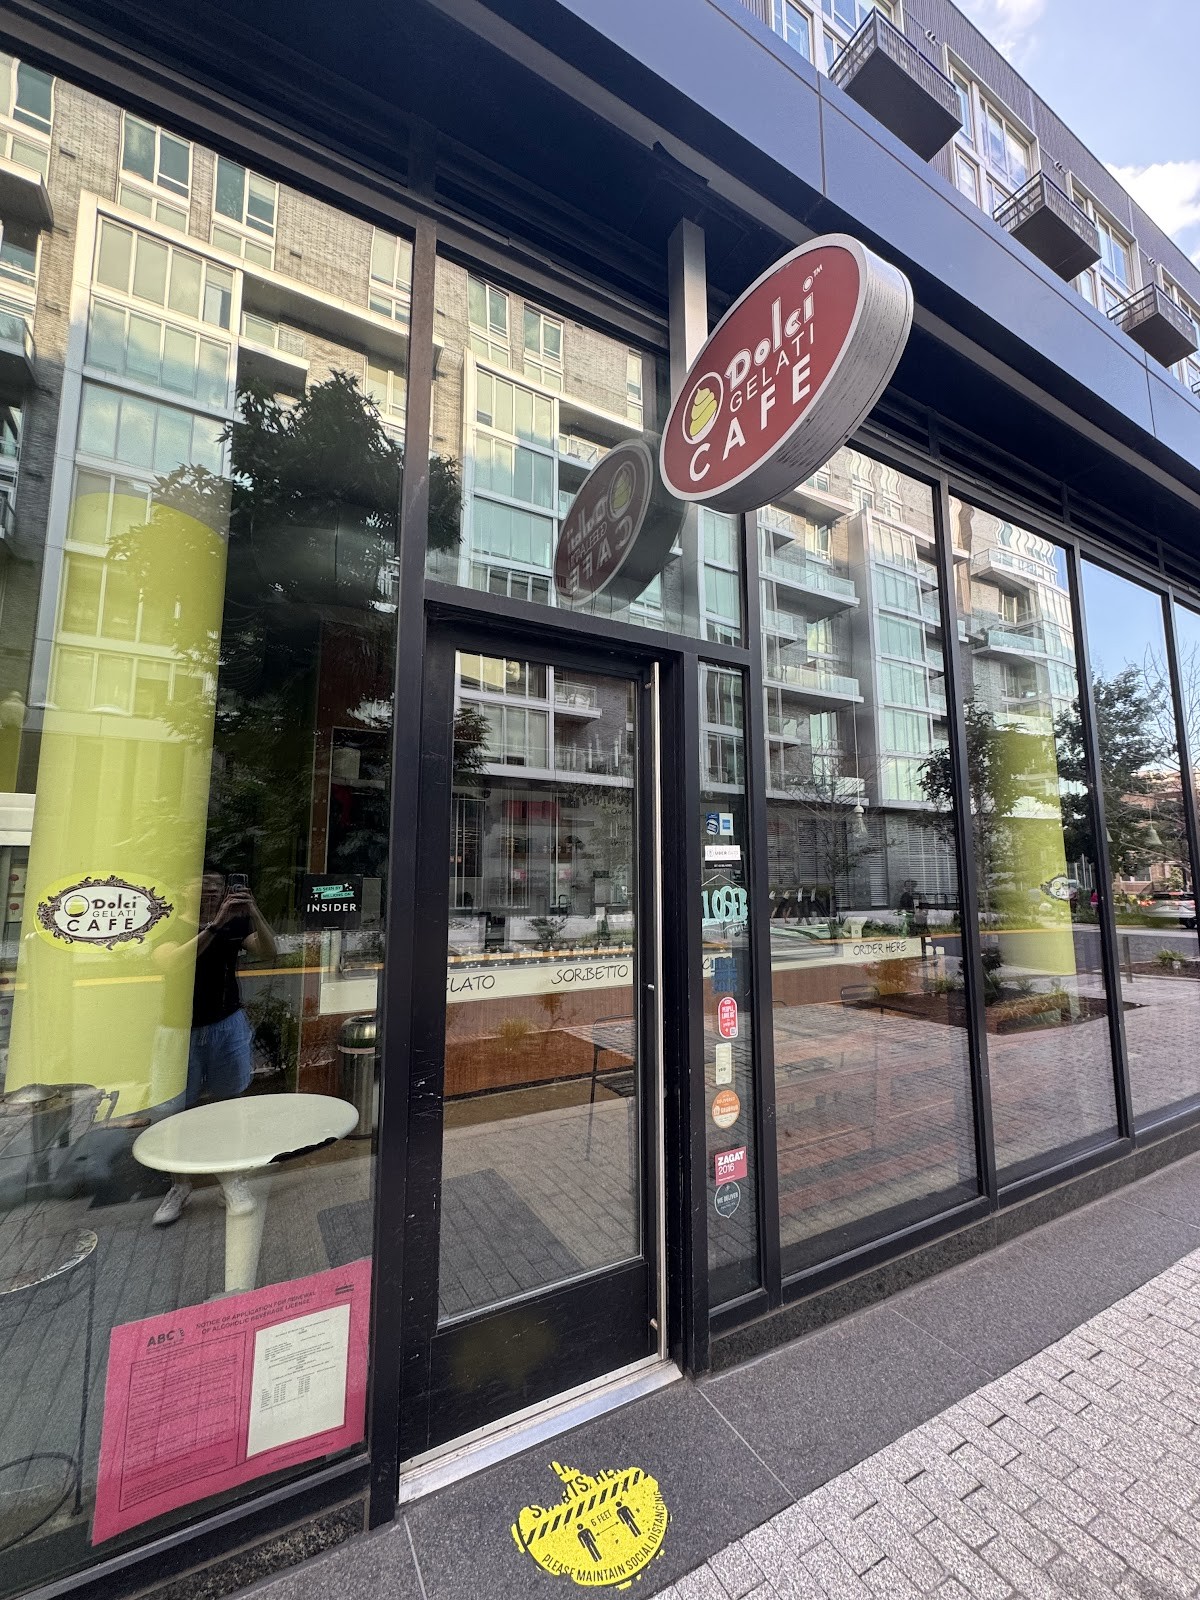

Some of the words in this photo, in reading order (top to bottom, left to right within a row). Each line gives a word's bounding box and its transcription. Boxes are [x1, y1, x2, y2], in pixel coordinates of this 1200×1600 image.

[724, 275, 815, 391] Dolci
[729, 322, 815, 413] GELATI
[689, 353, 811, 482] CAFE
[91, 893, 137, 909] Dolci
[306, 903, 357, 913] INSIDER
[92, 909, 136, 918] GELATI
[66, 918, 134, 932] CAFE
[853, 943, 884, 956] ORDER
[885, 940, 907, 953] HERE
[446, 975, 496, 993] LATO
[551, 964, 629, 985] SORBETTO
[717, 1150, 745, 1167] ZAGAT
[718, 1163, 735, 1175] 2016
[196, 1317, 221, 1329] NOTICE
[201, 1327, 211, 1335] OF
[211, 1317, 250, 1333] ALCOHOLIC
[146, 1330, 175, 1347] ABC
[590, 1516, 596, 1527] 6
[596, 1509, 612, 1524] FEET
[576, 1563, 627, 1582] MAINTAIN
[627, 1544, 655, 1571] SOCIAL
